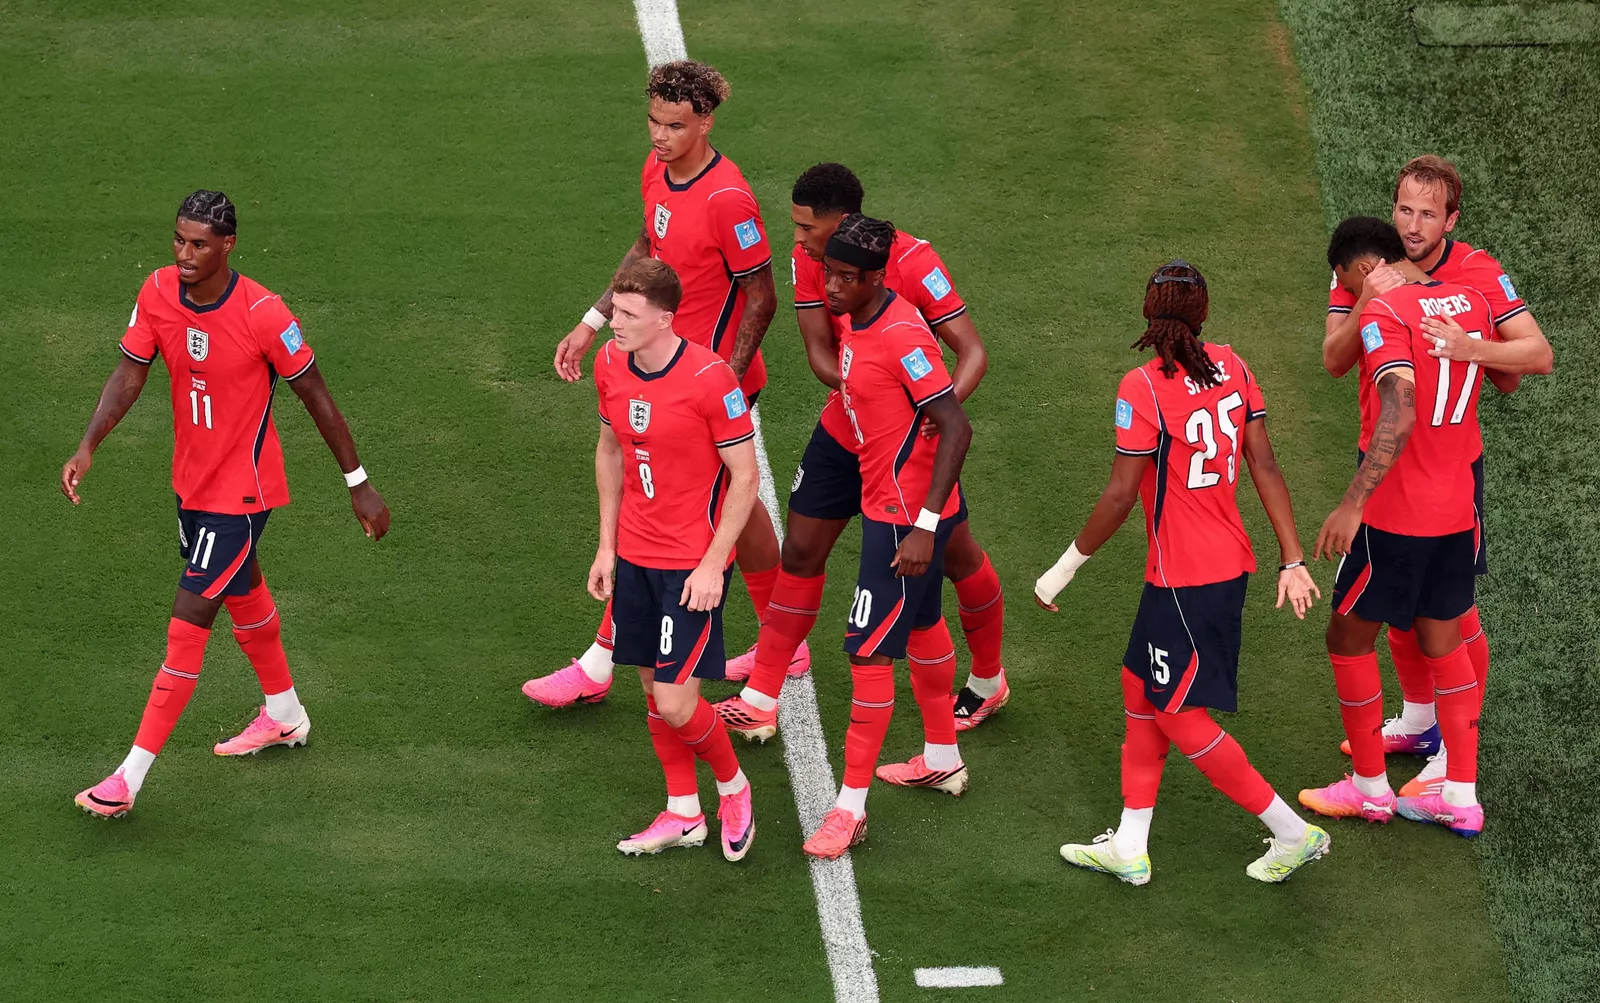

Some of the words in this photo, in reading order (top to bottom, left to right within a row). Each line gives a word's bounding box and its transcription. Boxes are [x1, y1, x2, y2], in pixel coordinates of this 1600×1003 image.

[189, 389, 213, 430] 11
[1184, 389, 1244, 490] 25
[638, 462, 655, 499] 8
[191, 526, 216, 570] 11
[659, 615, 674, 656] 8
